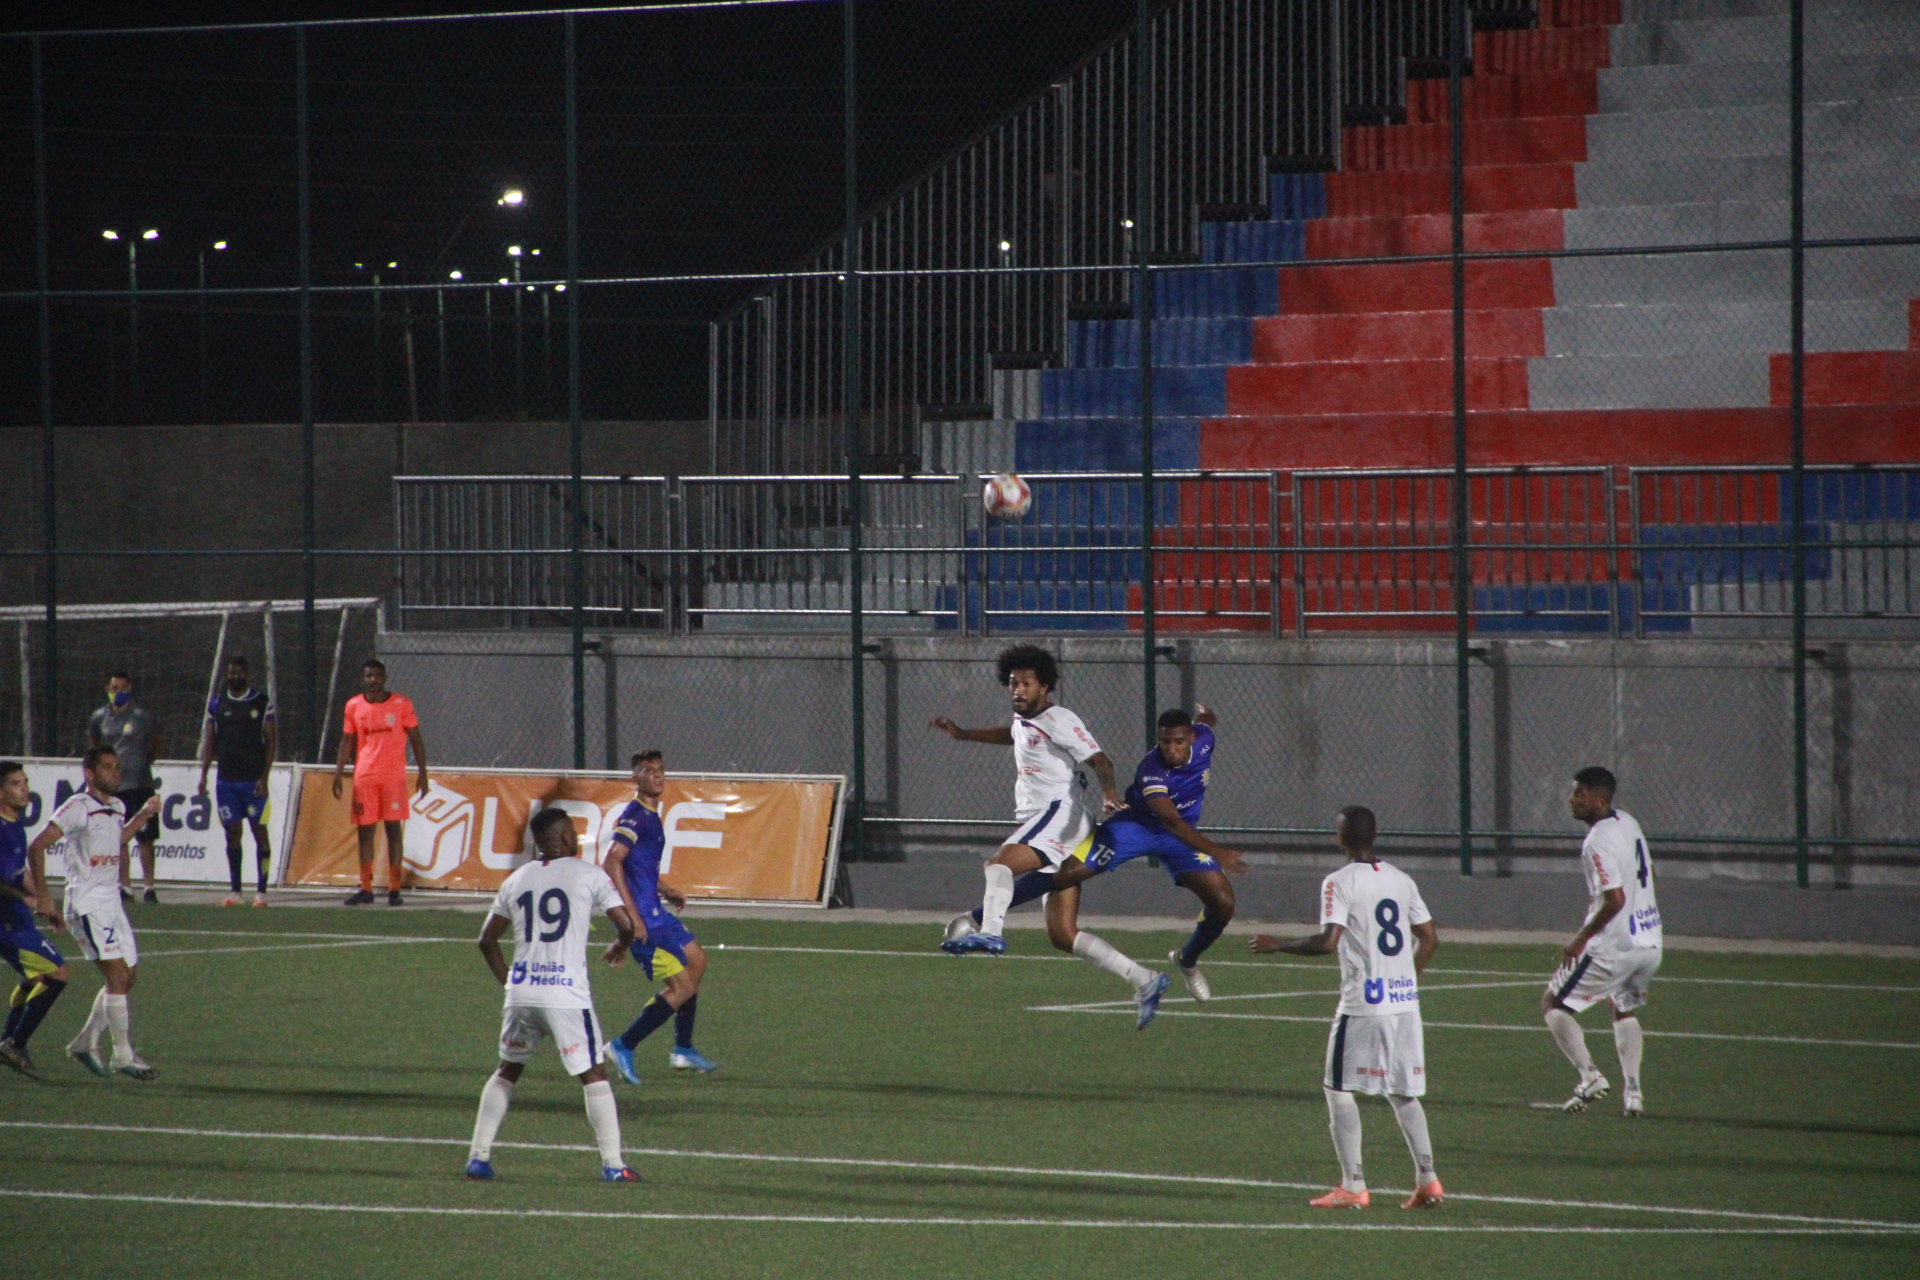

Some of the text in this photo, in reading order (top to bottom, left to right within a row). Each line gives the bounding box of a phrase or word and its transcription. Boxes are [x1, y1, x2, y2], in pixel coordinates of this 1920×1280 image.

[131, 843, 206, 859] mmentos
[1090, 843, 1116, 866] 15
[1635, 838, 1648, 888] 4
[517, 887, 571, 943] 19
[1375, 898, 1404, 957] 8
[532, 962, 565, 973] União
[530, 974, 573, 986] Médica
